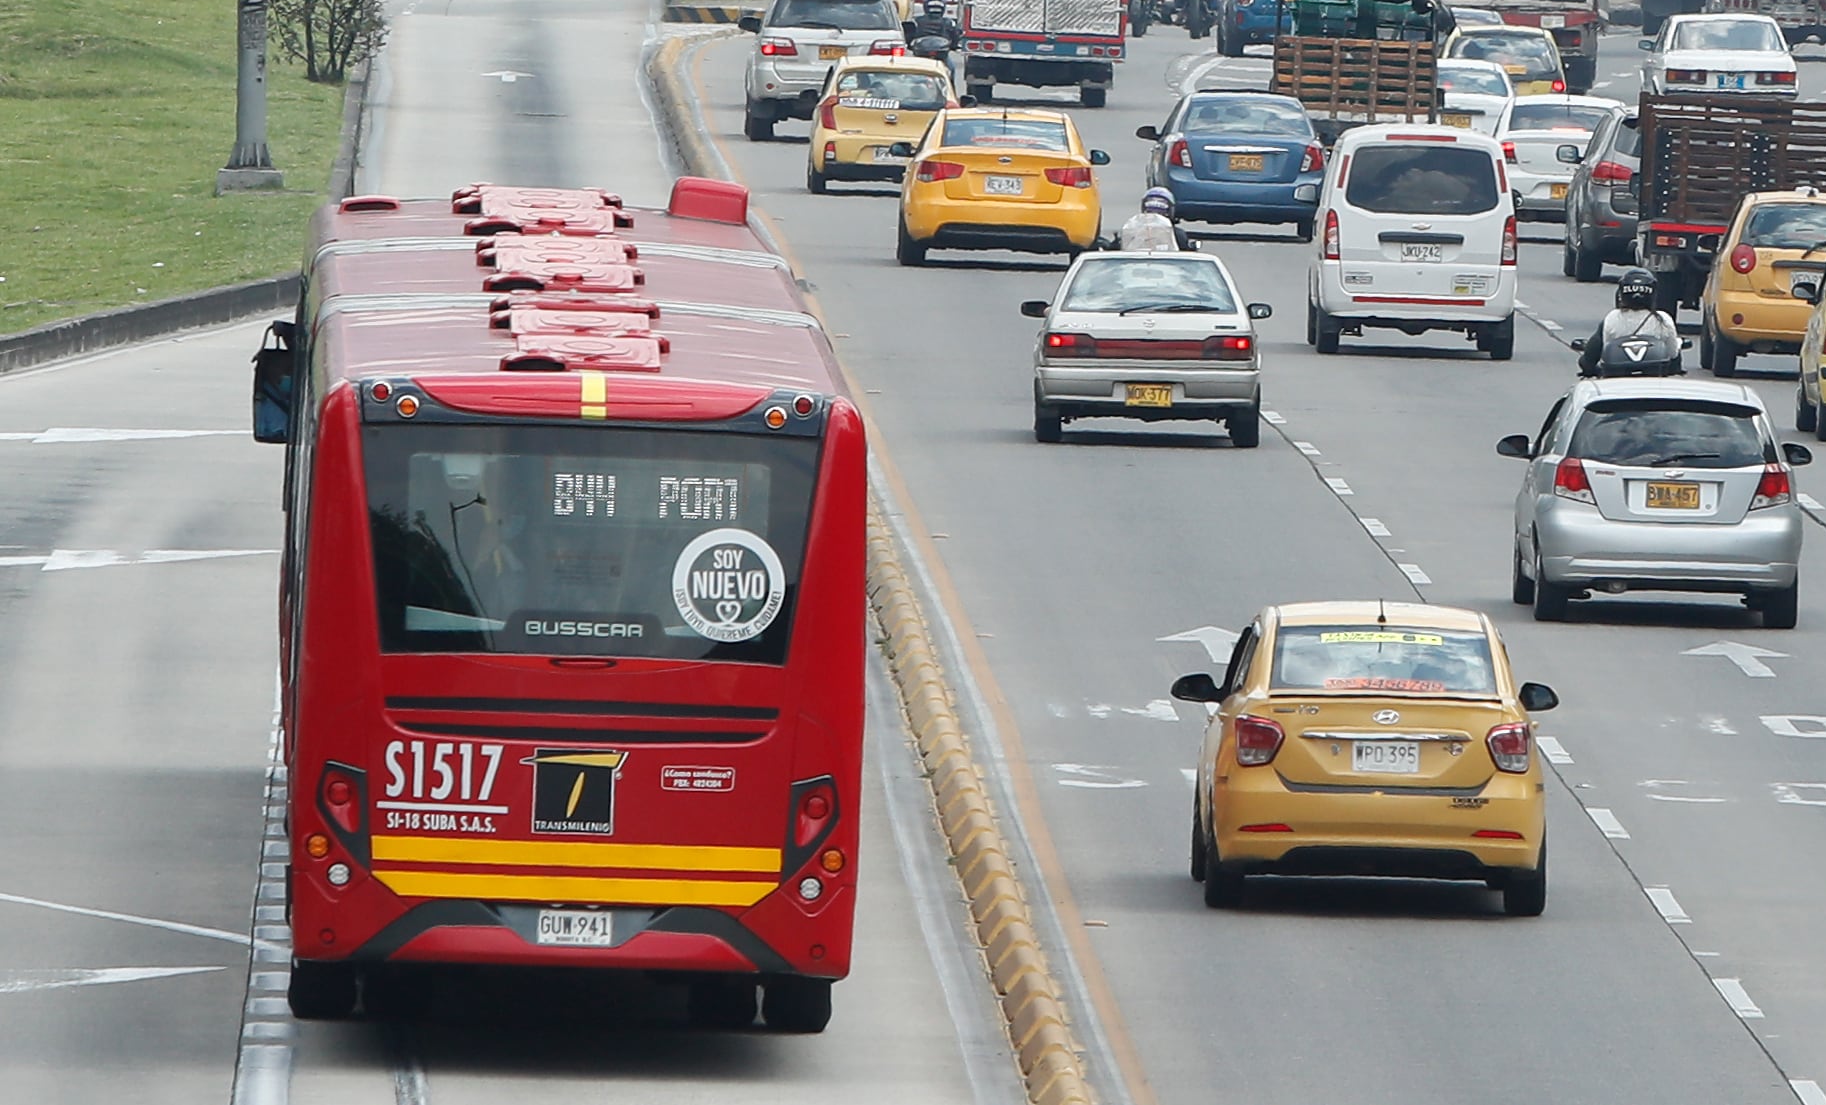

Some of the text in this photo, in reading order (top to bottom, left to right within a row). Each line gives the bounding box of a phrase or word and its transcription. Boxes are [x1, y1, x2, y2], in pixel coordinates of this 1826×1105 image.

[658, 476, 739, 521] PORT
[713, 548, 744, 570] SOY
[692, 570, 766, 600] NUEVO
[525, 620, 644, 640] BUSSCAR
[384, 740, 505, 802] S1517
[386, 812, 498, 834] SI-18 SUBA S.A.S.
[534, 819, 611, 833] TRANSMILENIO
